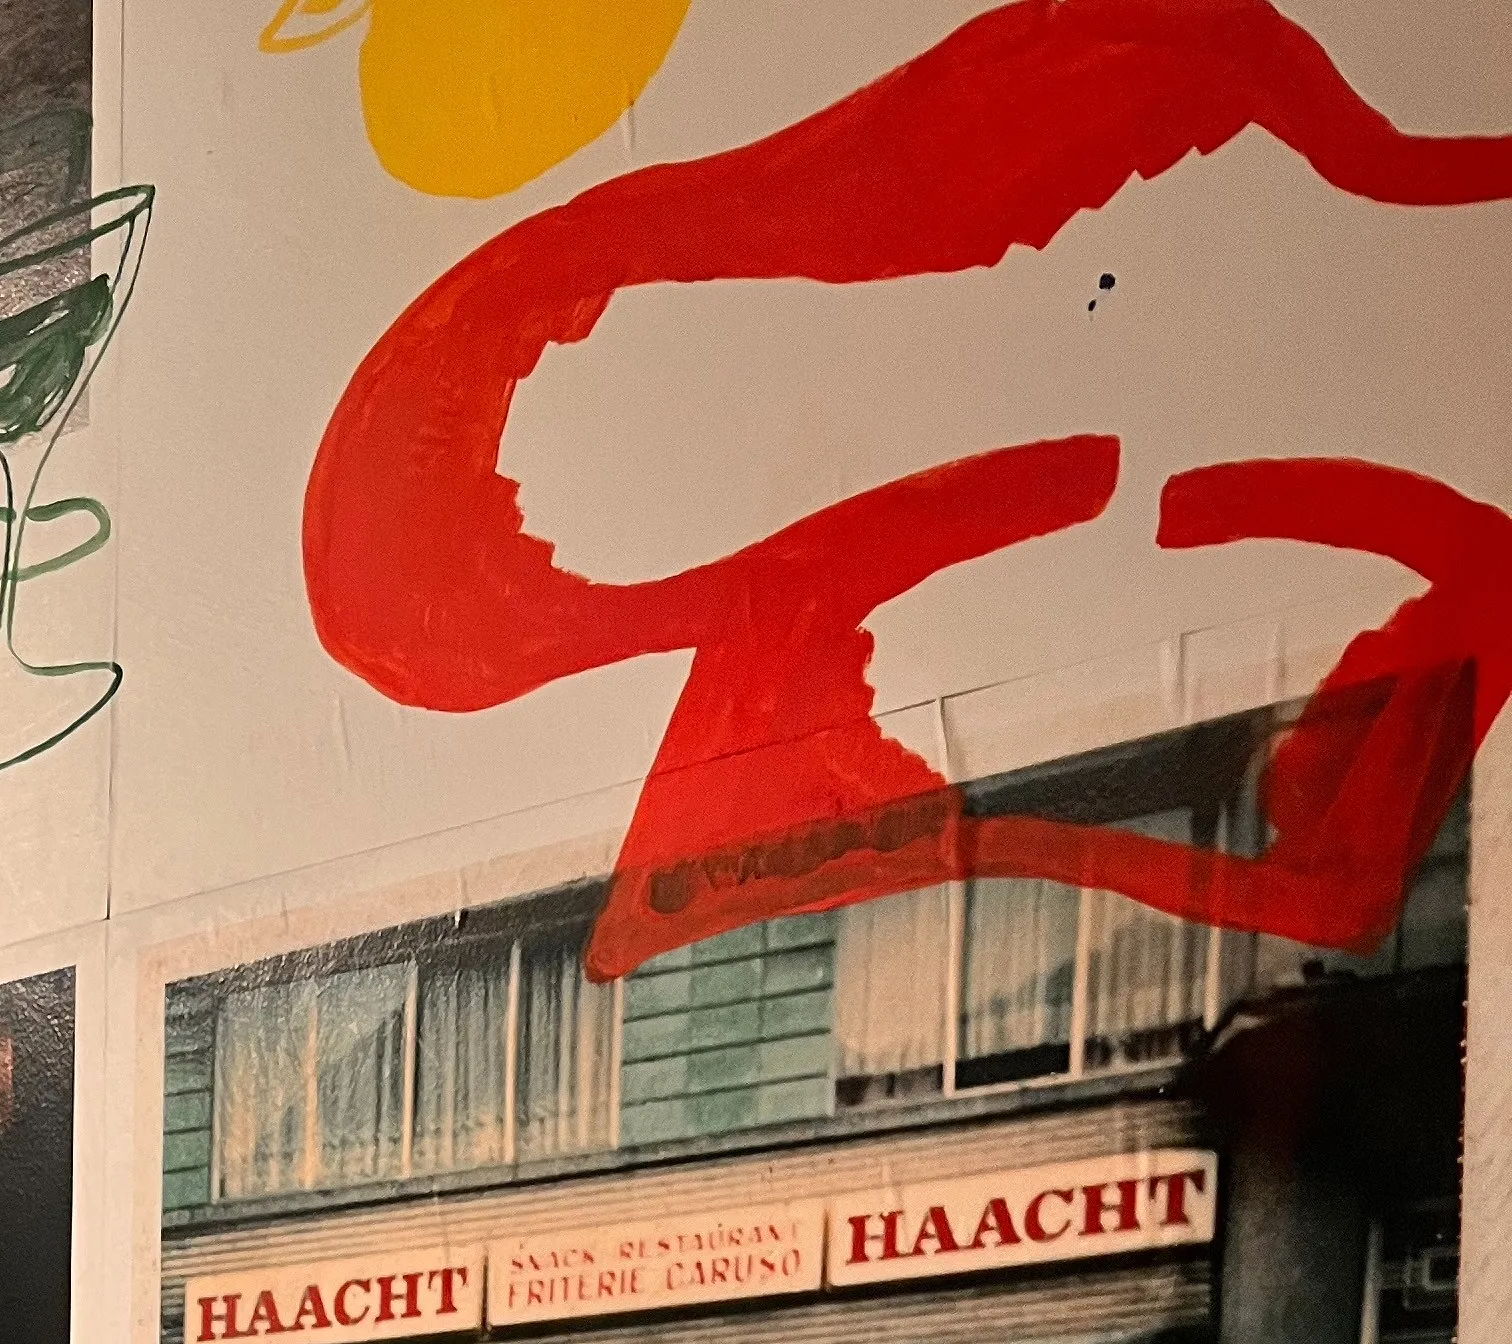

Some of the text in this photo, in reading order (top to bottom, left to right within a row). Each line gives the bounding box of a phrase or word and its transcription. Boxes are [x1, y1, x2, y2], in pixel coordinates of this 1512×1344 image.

[845, 1168, 1207, 1267] HAACHT
[195, 1266, 468, 1343] HAACHT
[666, 1248, 802, 1291] CARUSO
